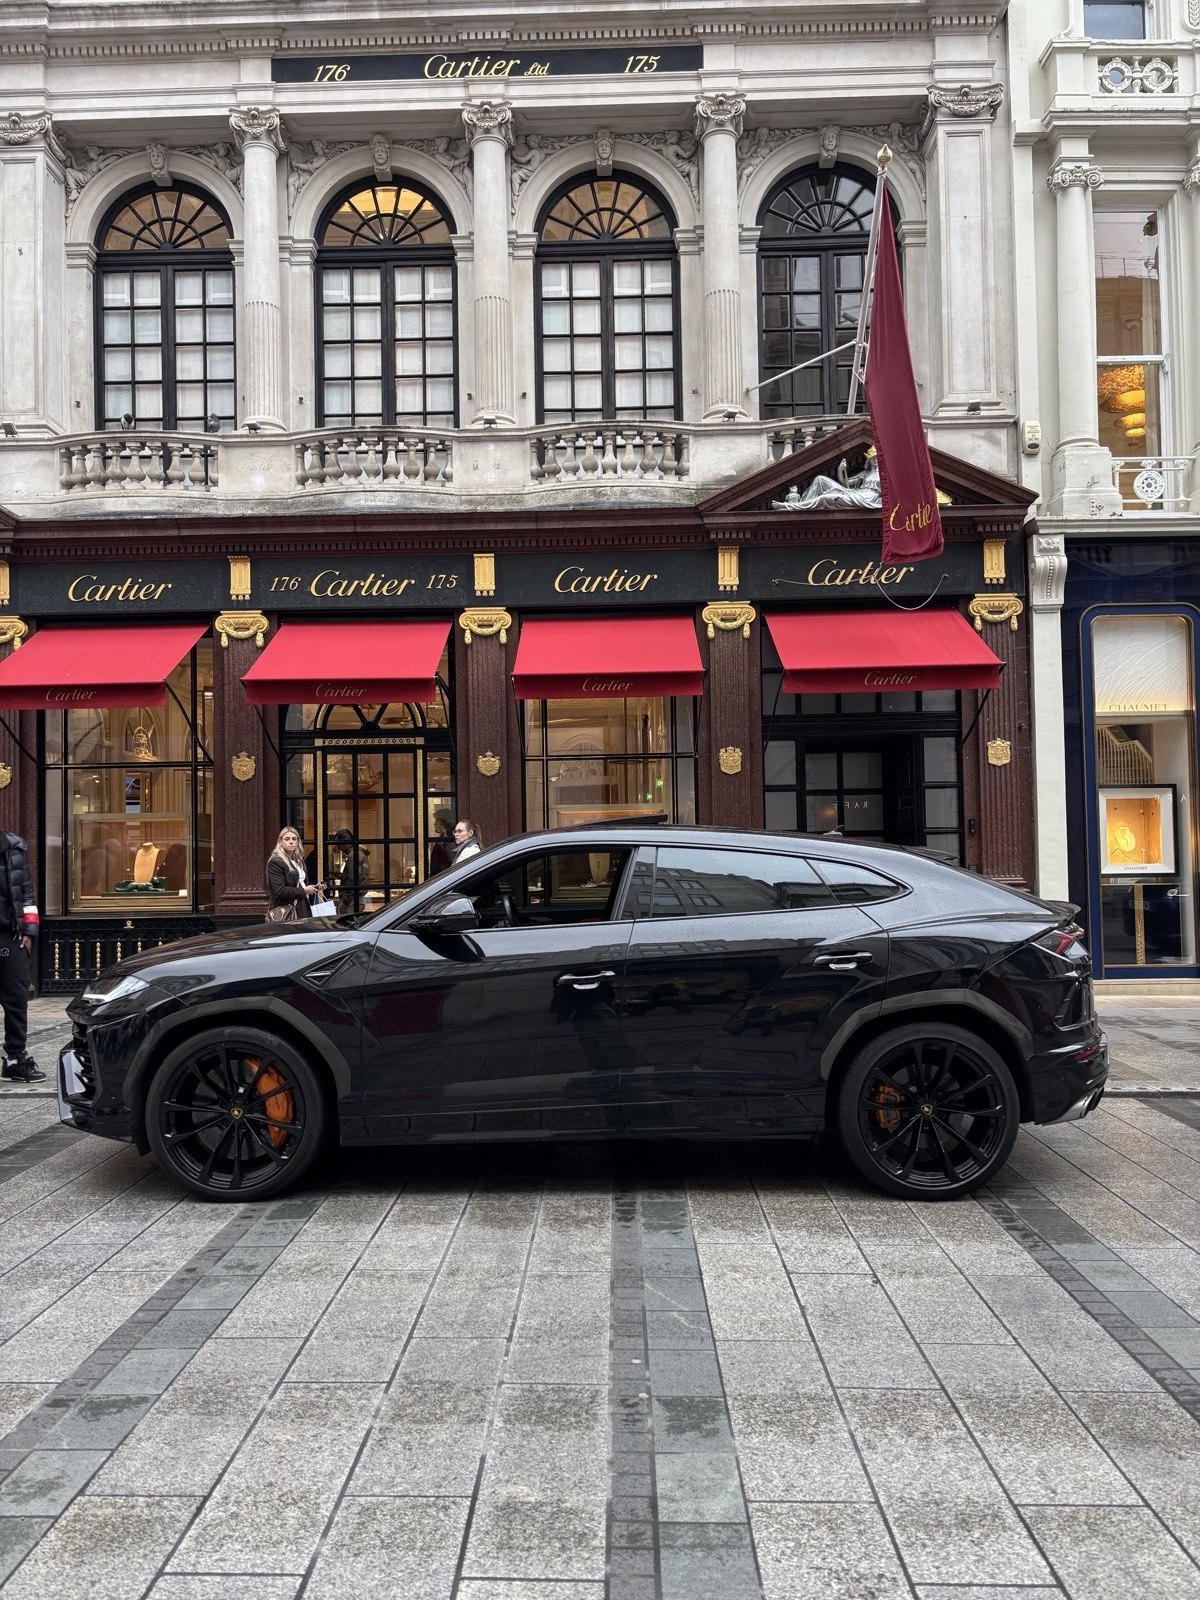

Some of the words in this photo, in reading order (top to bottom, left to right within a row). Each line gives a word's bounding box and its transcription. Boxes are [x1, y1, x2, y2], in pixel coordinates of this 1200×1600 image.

[313, 64, 350, 82] 176
[423, 54, 521, 79] Cartier
[524, 62, 550, 76] Ltd
[622, 55, 661, 73] 175
[553, 566, 658, 594] Cartier
[807, 558, 915, 586] Cartier
[67, 574, 173, 603] Cartier
[269, 576, 302, 592] 176
[310, 569, 415, 598] Cartier
[425, 573, 459, 589] 175
[314, 682, 368, 698] Cartier
[581, 677, 634, 693] Cartier
[864, 671, 917, 687] Cartier
[45, 687, 98, 702] Cartier
[1109, 703, 1169, 711] CHAUMET
